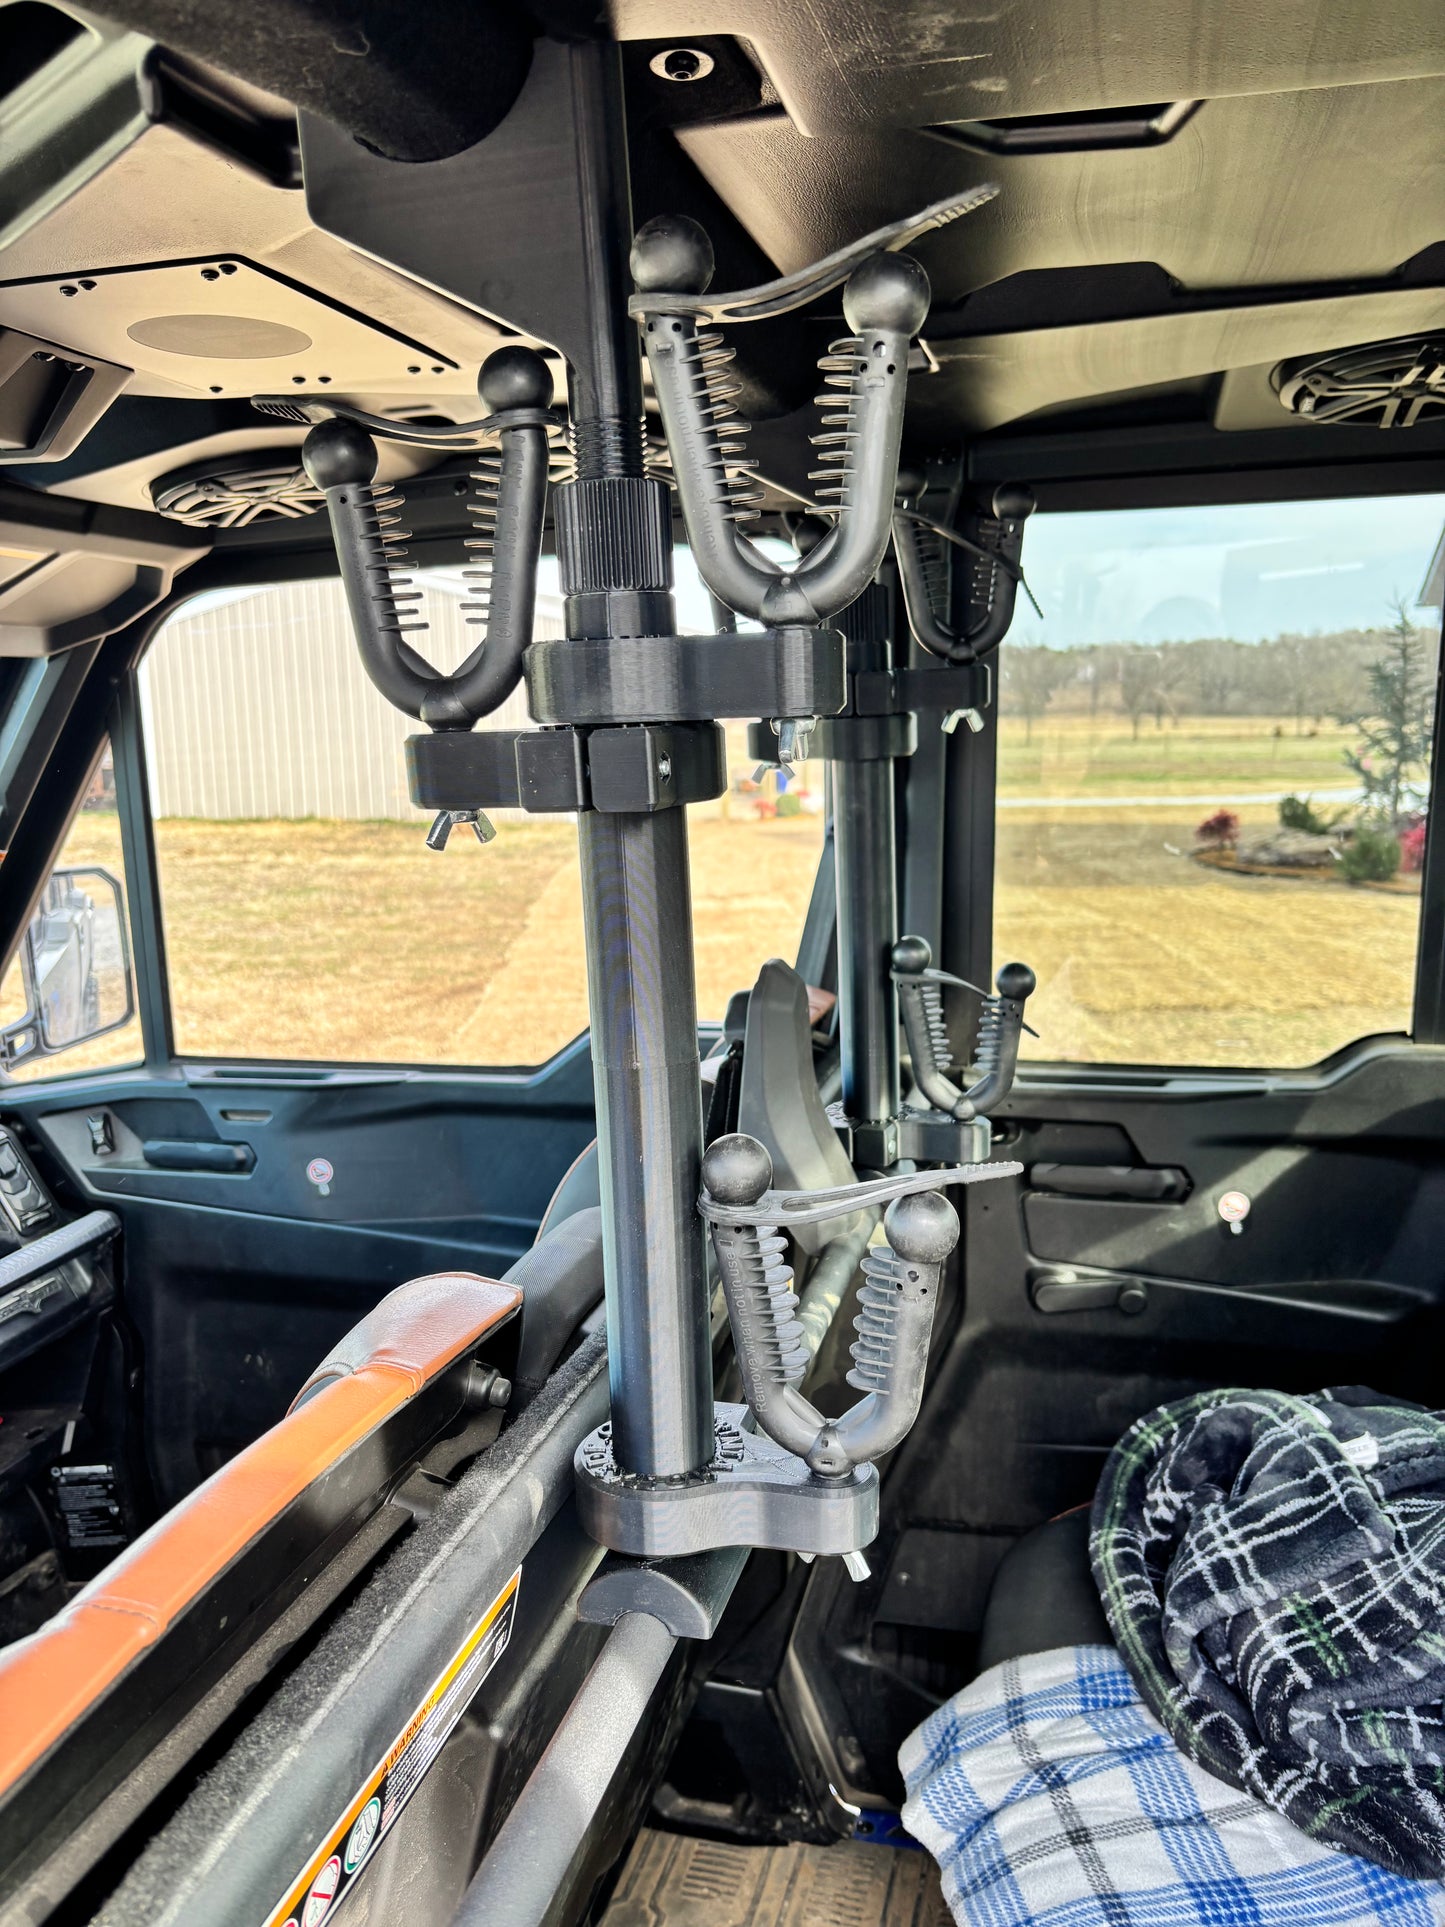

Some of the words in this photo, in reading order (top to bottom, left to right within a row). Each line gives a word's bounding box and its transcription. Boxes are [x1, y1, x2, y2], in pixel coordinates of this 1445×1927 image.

[727, 1252, 740, 1277] use
[730, 1278, 744, 1293] in
[734, 1294, 748, 1317] not
[740, 1319, 755, 1356] when
[749, 1357, 768, 1413] Remove
[390, 1695, 435, 1765] WARNING
